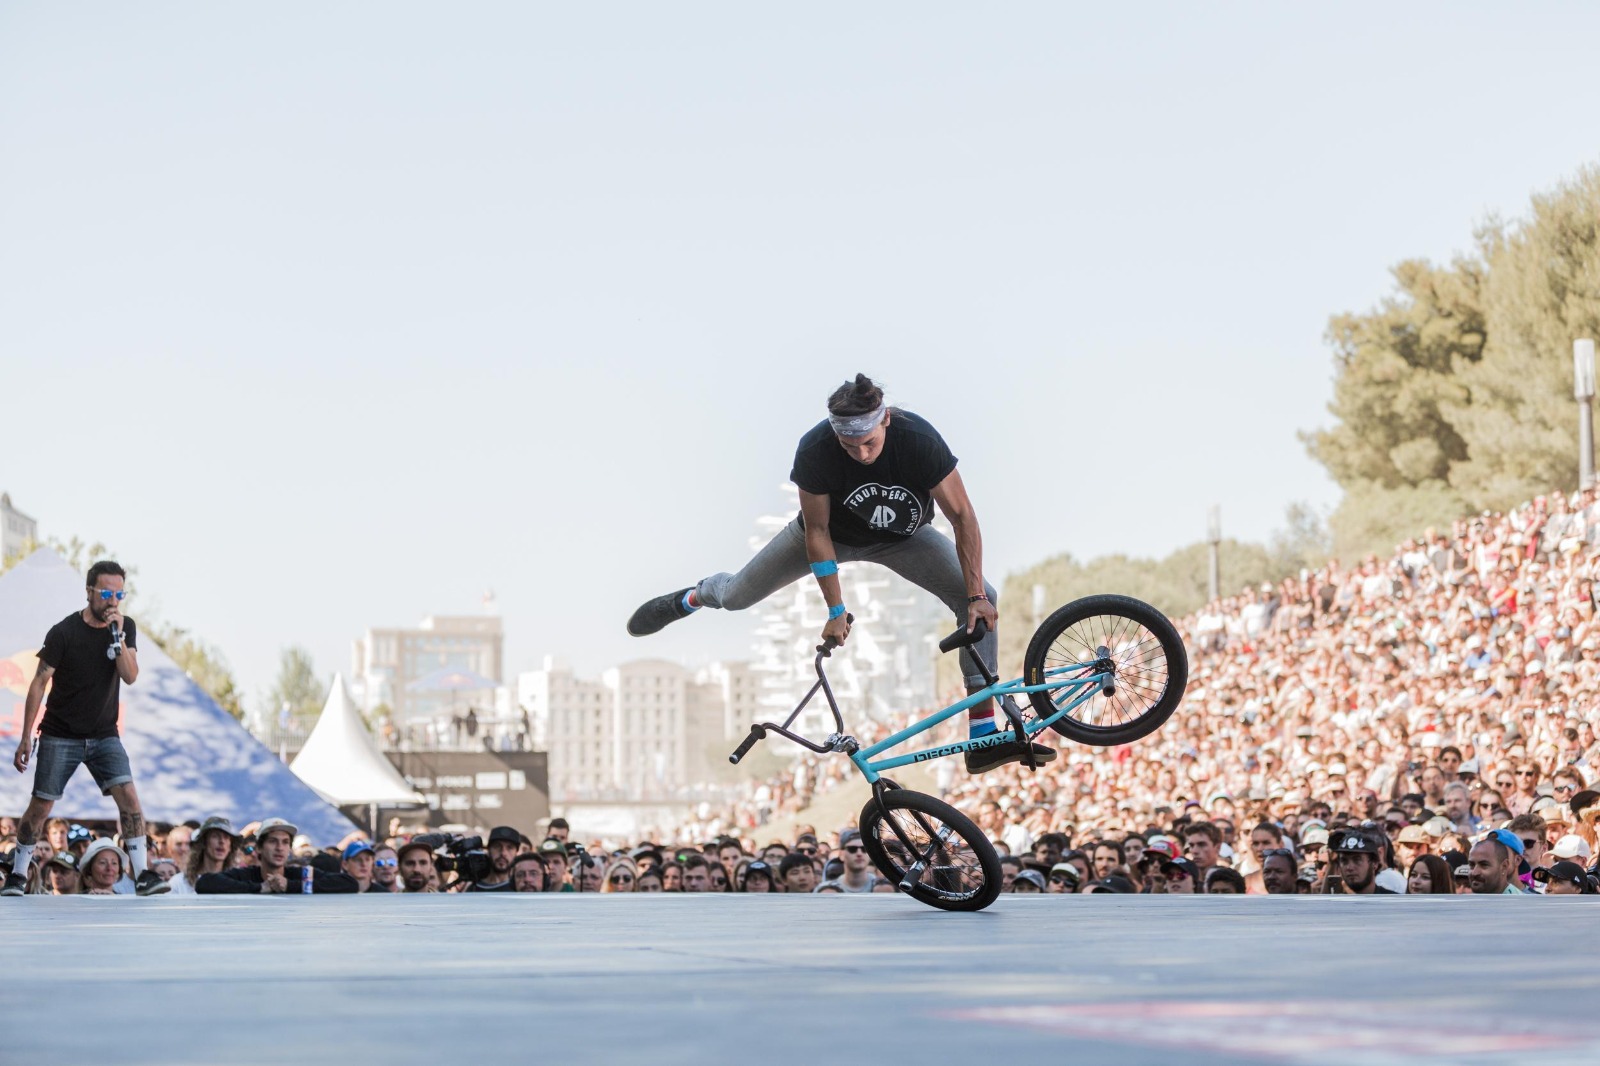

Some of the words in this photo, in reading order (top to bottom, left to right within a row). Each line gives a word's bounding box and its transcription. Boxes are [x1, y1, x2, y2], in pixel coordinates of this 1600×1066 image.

[849, 486, 878, 507] FOUR
[881, 489, 907, 502] PEGS
[913, 745, 964, 762] DECO
[965, 735, 1008, 752] BMX
